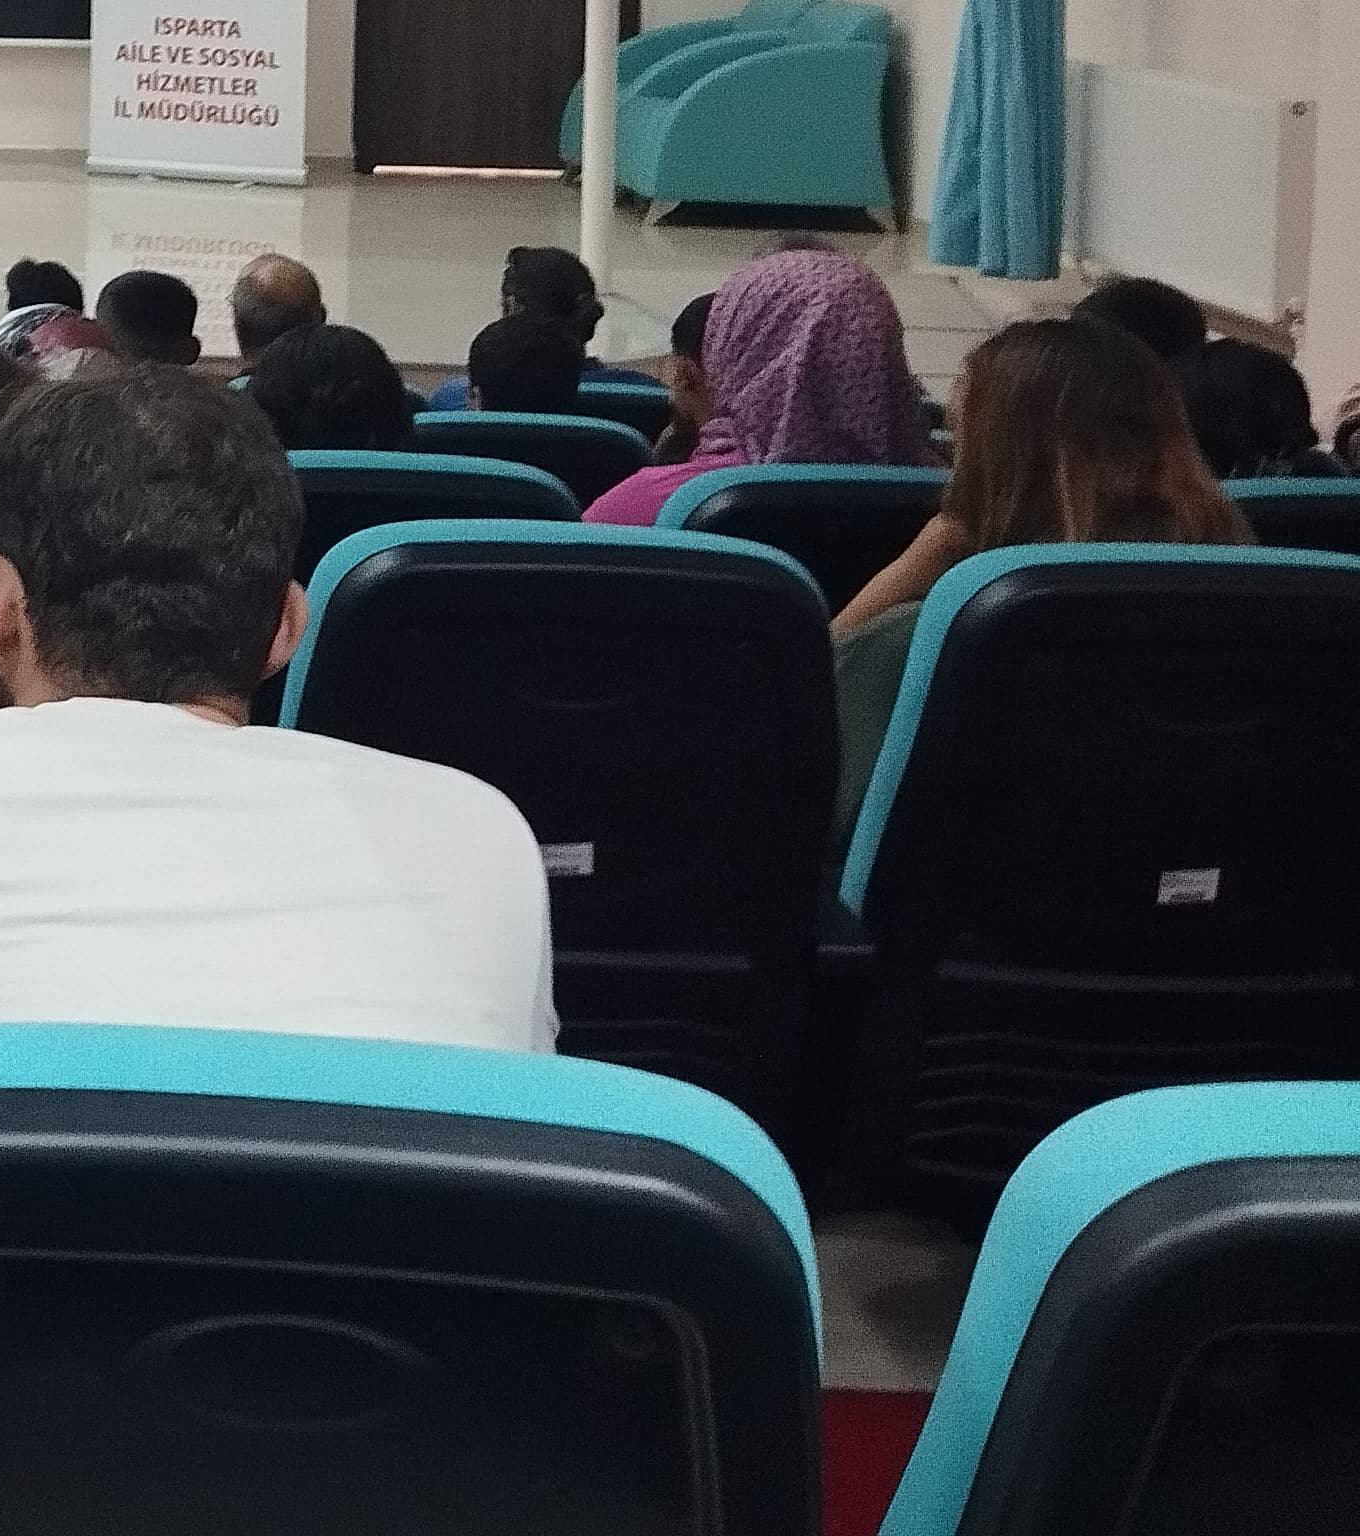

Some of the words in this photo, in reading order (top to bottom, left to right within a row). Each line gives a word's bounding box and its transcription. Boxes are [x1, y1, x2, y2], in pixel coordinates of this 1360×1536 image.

[154, 16, 242, 39] ISPARTA
[115, 41, 162, 64] AİLE
[167, 45, 194, 64] VE
[199, 47, 280, 69] SOSYAL
[136, 69, 258, 96] HİZMETLER
[113, 96, 132, 119] İL
[137, 98, 280, 127] MÜDÜRLÜĞÜ
